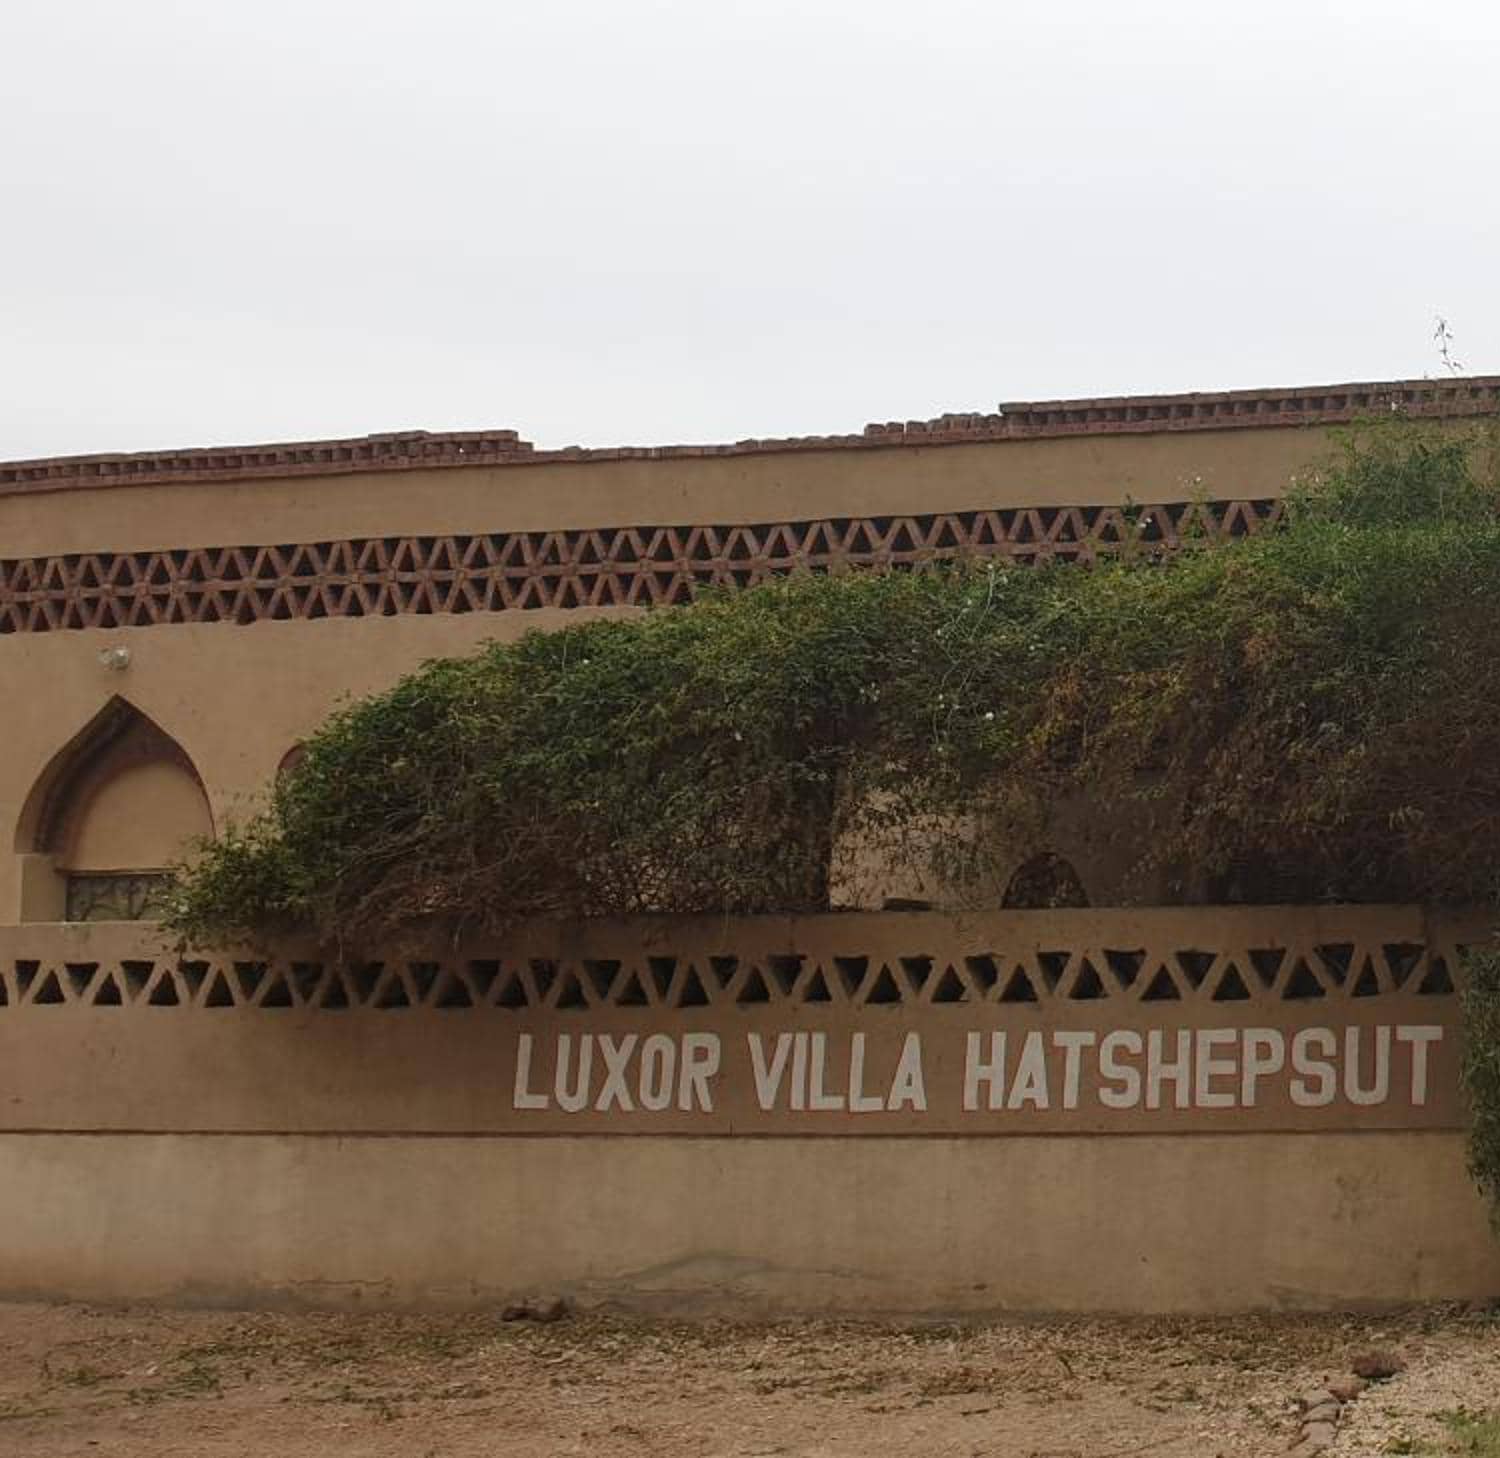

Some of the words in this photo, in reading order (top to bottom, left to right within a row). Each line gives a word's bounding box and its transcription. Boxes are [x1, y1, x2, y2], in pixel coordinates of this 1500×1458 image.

[513, 1032, 721, 1112] LUXOR
[747, 1031, 928, 1111] VILLA
[962, 1026, 1443, 1110] HATSHEPSUT
